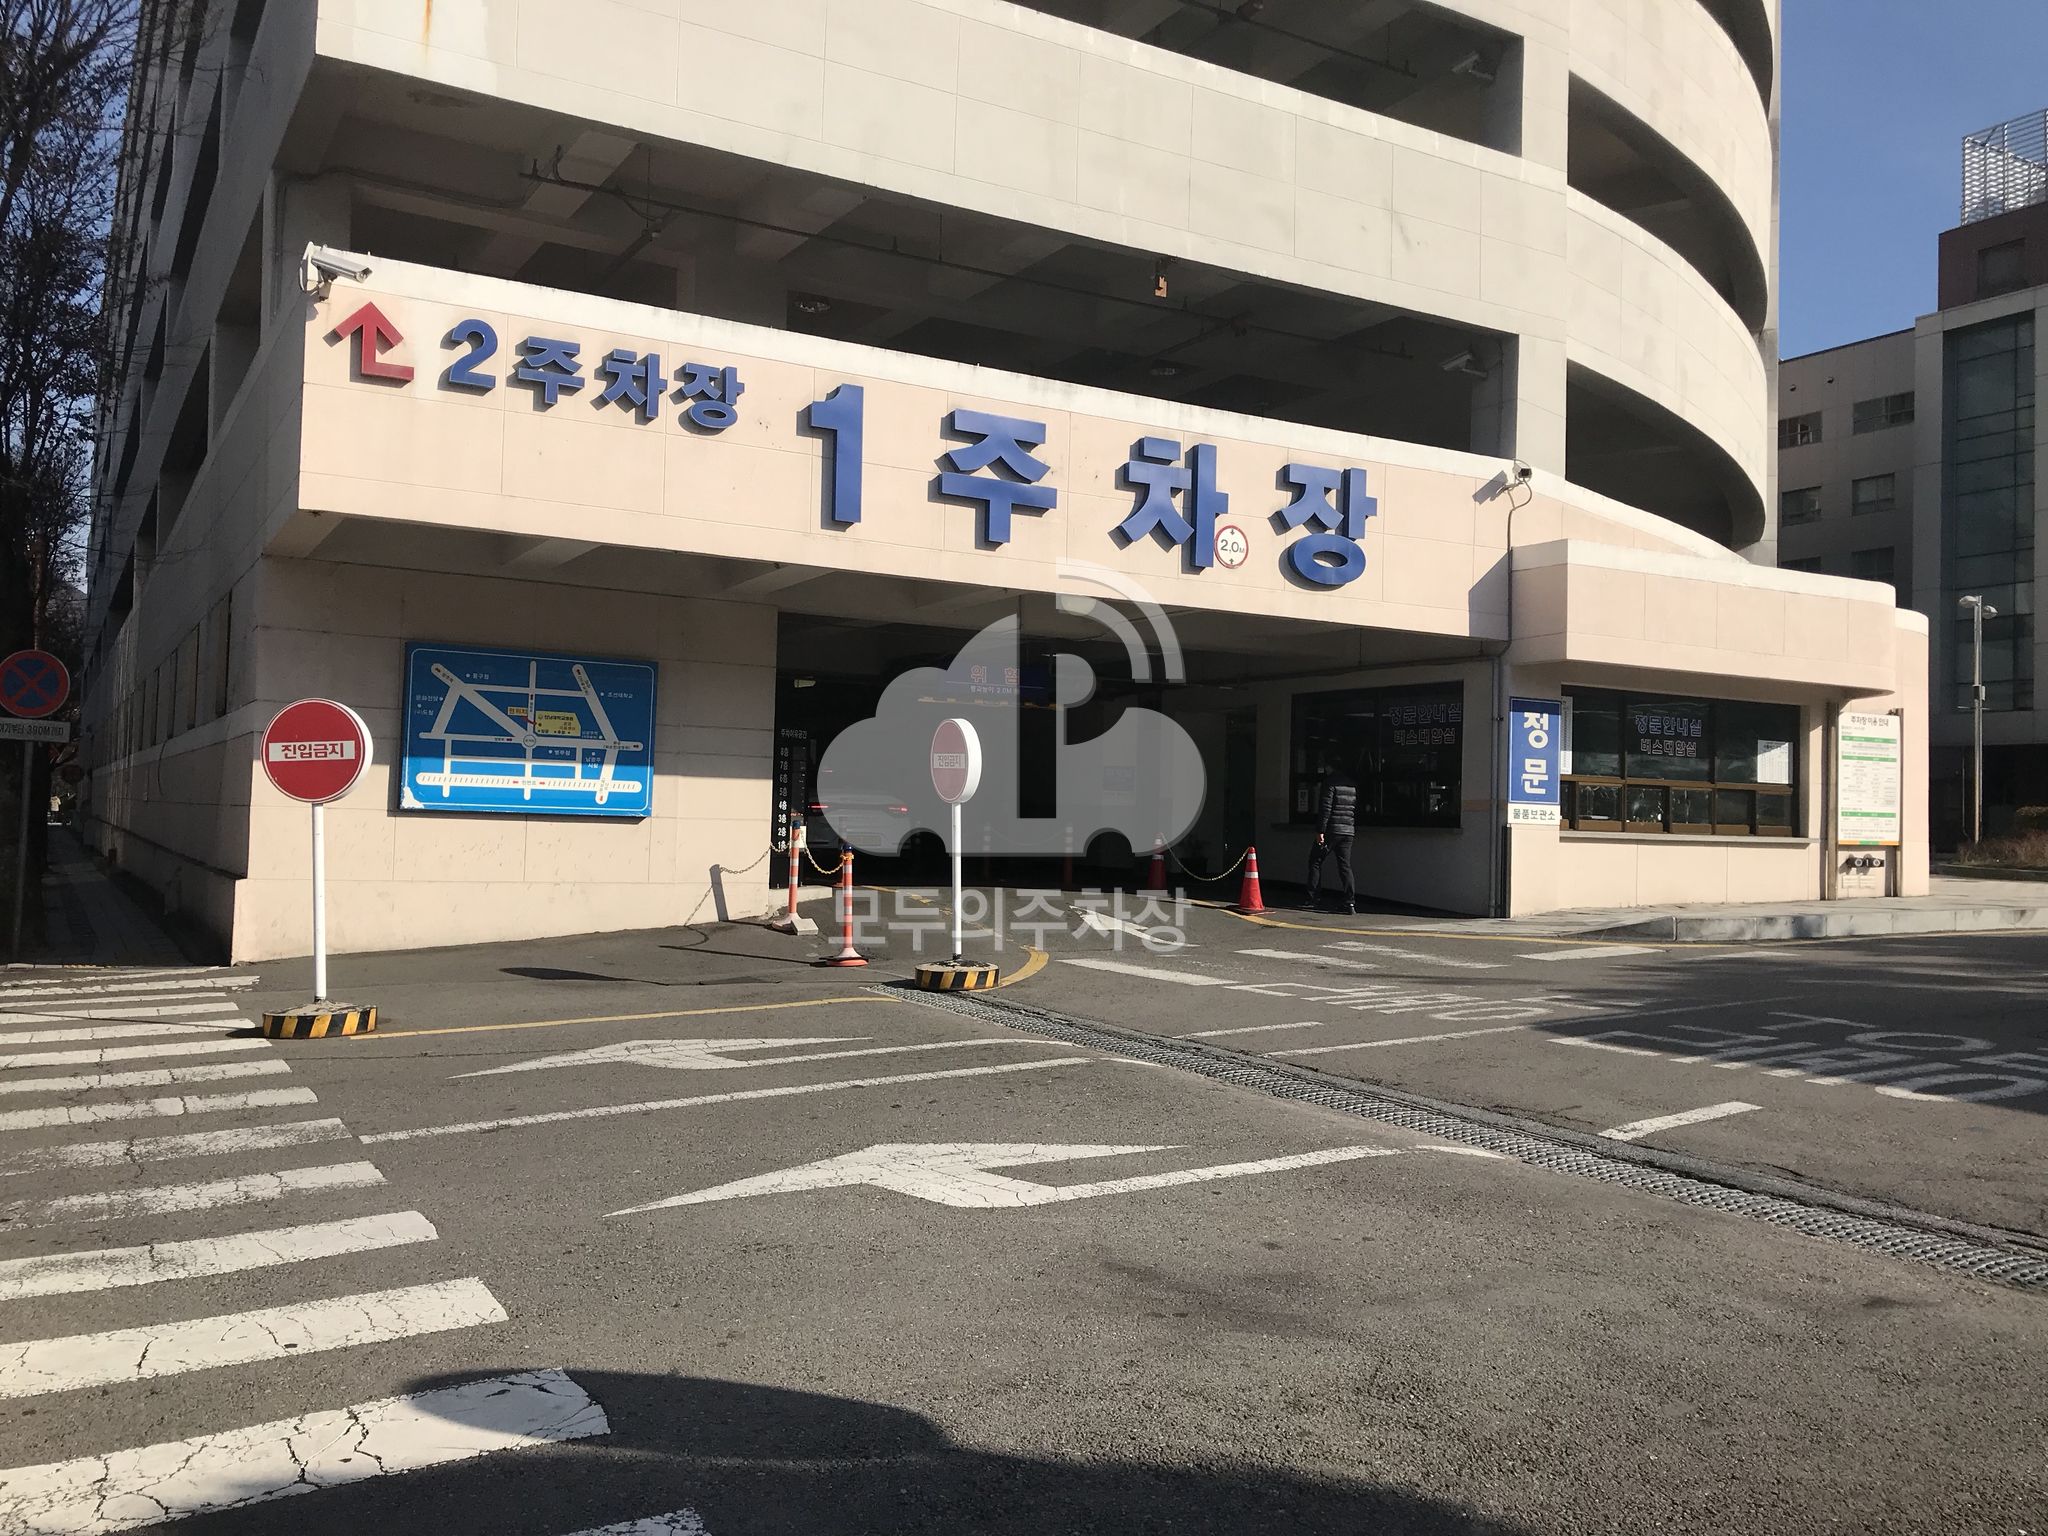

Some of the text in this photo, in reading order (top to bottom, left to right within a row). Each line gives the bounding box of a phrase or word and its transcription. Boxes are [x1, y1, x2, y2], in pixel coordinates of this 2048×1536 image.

[446, 318, 745, 430] 2주차장
[806, 383, 1378, 586] 1주차장
[1635, 714, 1703, 738] 정문안내실
[281, 743, 344, 760] 진입금지
[936, 754, 961, 768] 진입금지
[1521, 711, 1550, 796] 정문
[1512, 808, 1556, 822] 물품보관소
